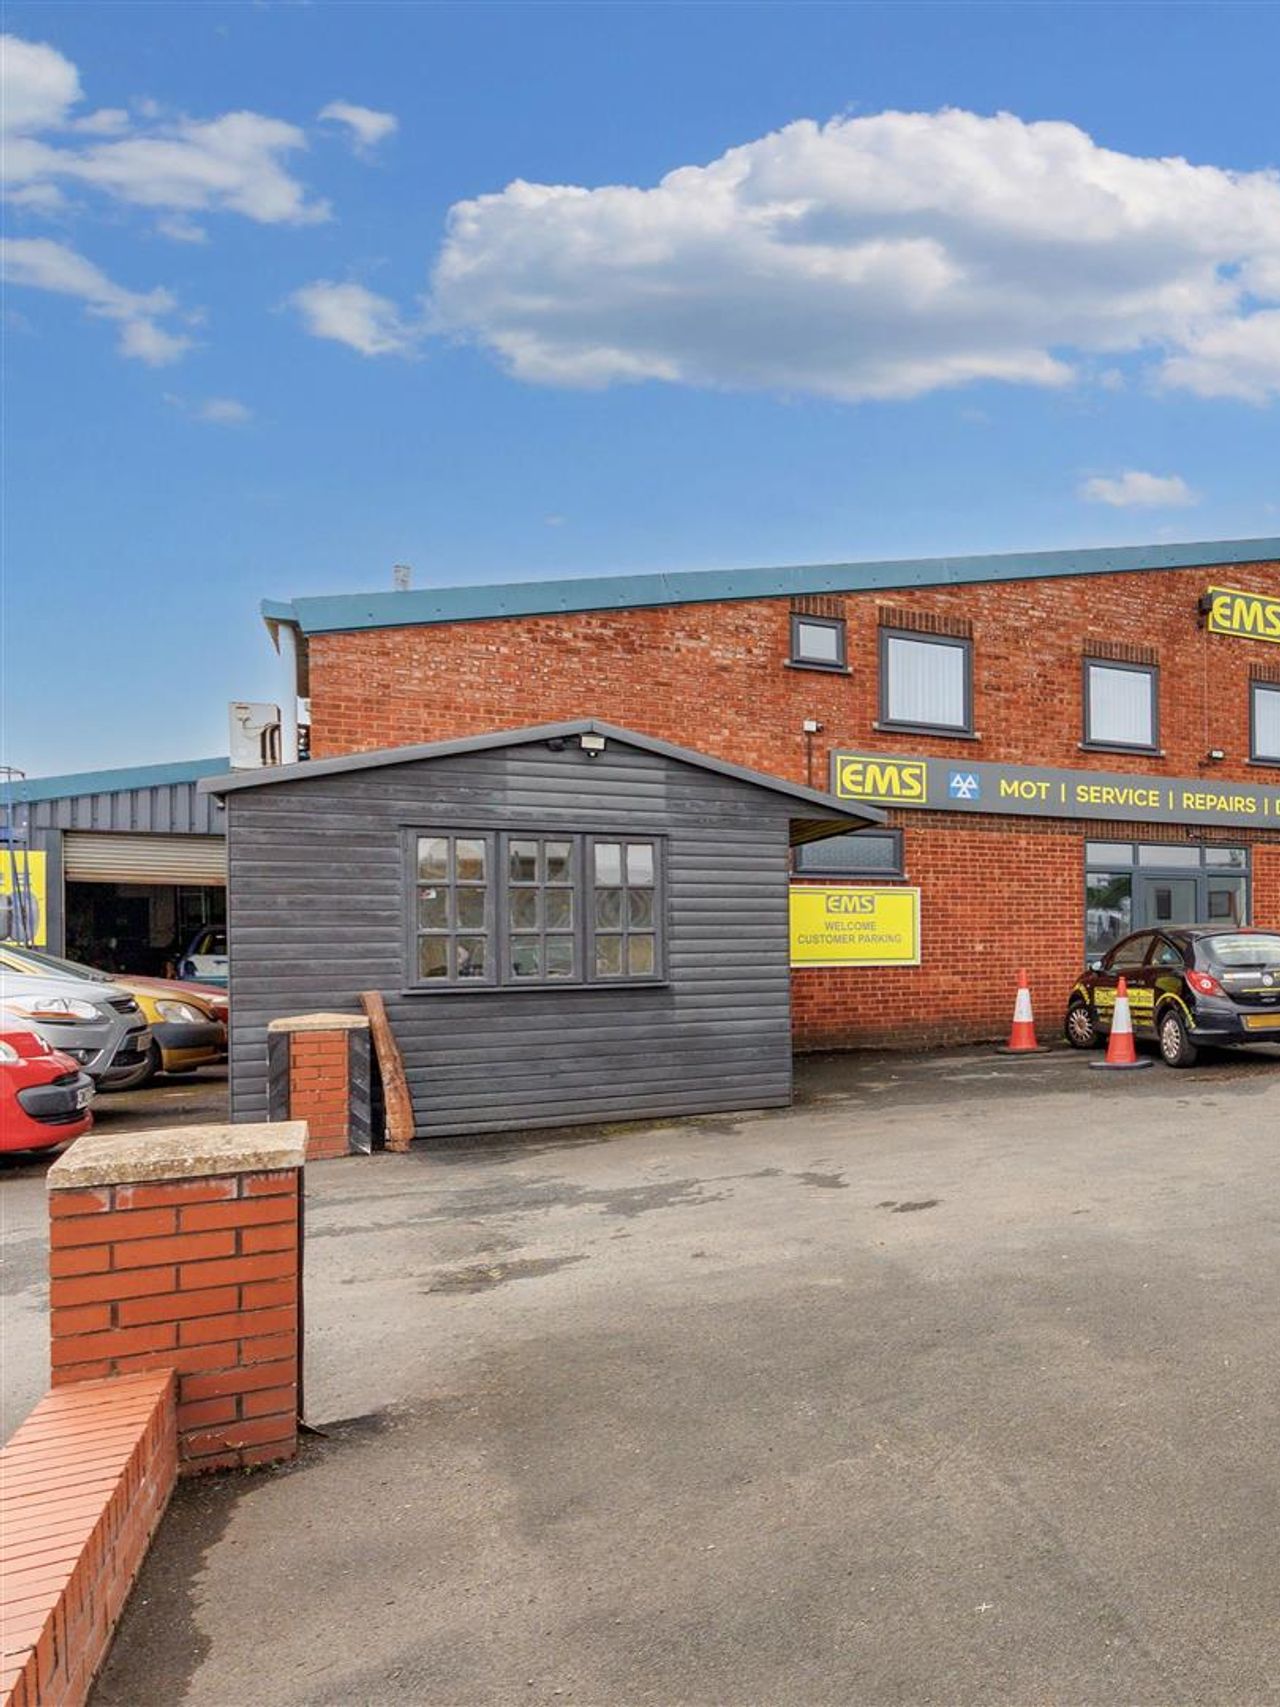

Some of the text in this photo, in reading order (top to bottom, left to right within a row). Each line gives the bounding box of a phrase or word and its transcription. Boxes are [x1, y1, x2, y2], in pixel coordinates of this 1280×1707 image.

[842, 763, 922, 797] EMS
[1000, 779, 1050, 799] MOT
[1076, 785, 1160, 808] SERVICE
[1183, 793, 1257, 814] REPAIRS
[827, 895, 874, 913] EMS
[825, 921, 877, 931] WELCOME
[798, 933, 902, 944] CUSTOMER PARKING
